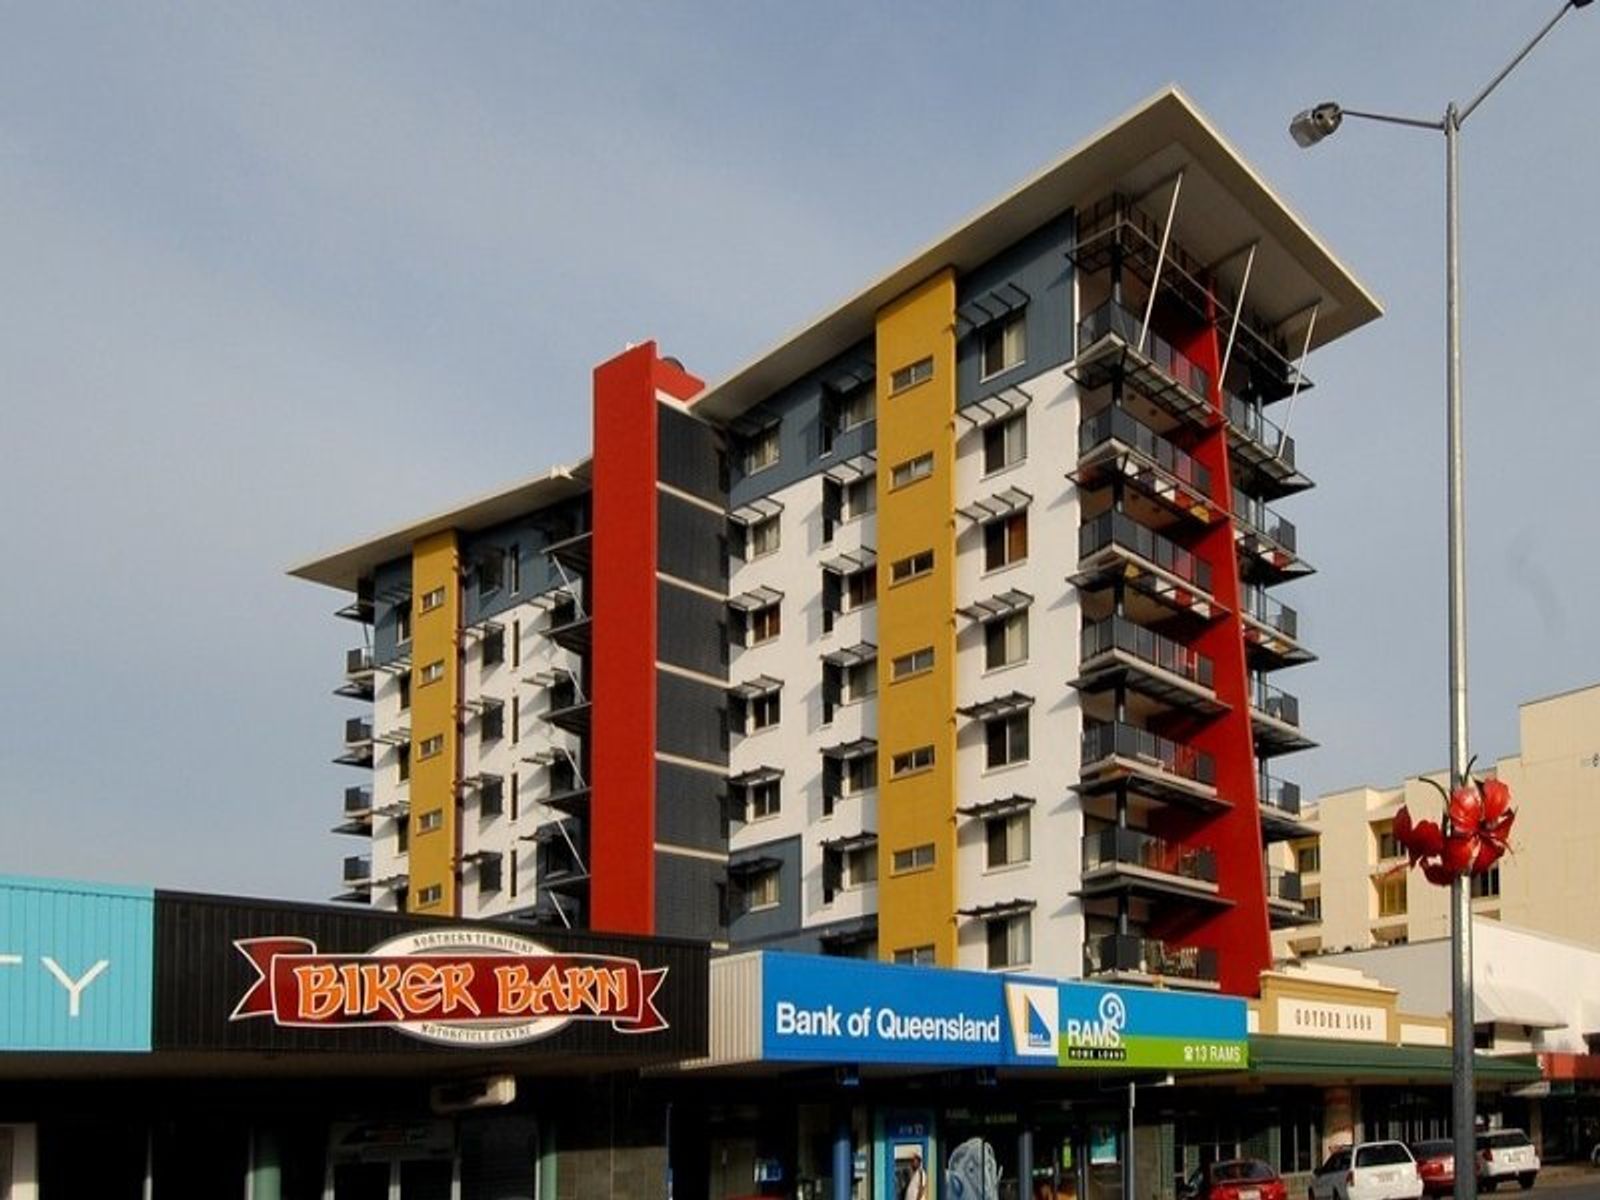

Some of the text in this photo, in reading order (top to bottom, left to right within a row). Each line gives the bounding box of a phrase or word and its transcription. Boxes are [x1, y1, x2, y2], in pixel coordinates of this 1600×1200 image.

[293, 962, 628, 1019] BIKER BARN
[776, 1001, 1000, 1044] Bank of Queensland
[1195, 1046, 1241, 1062] 13 RAMS
